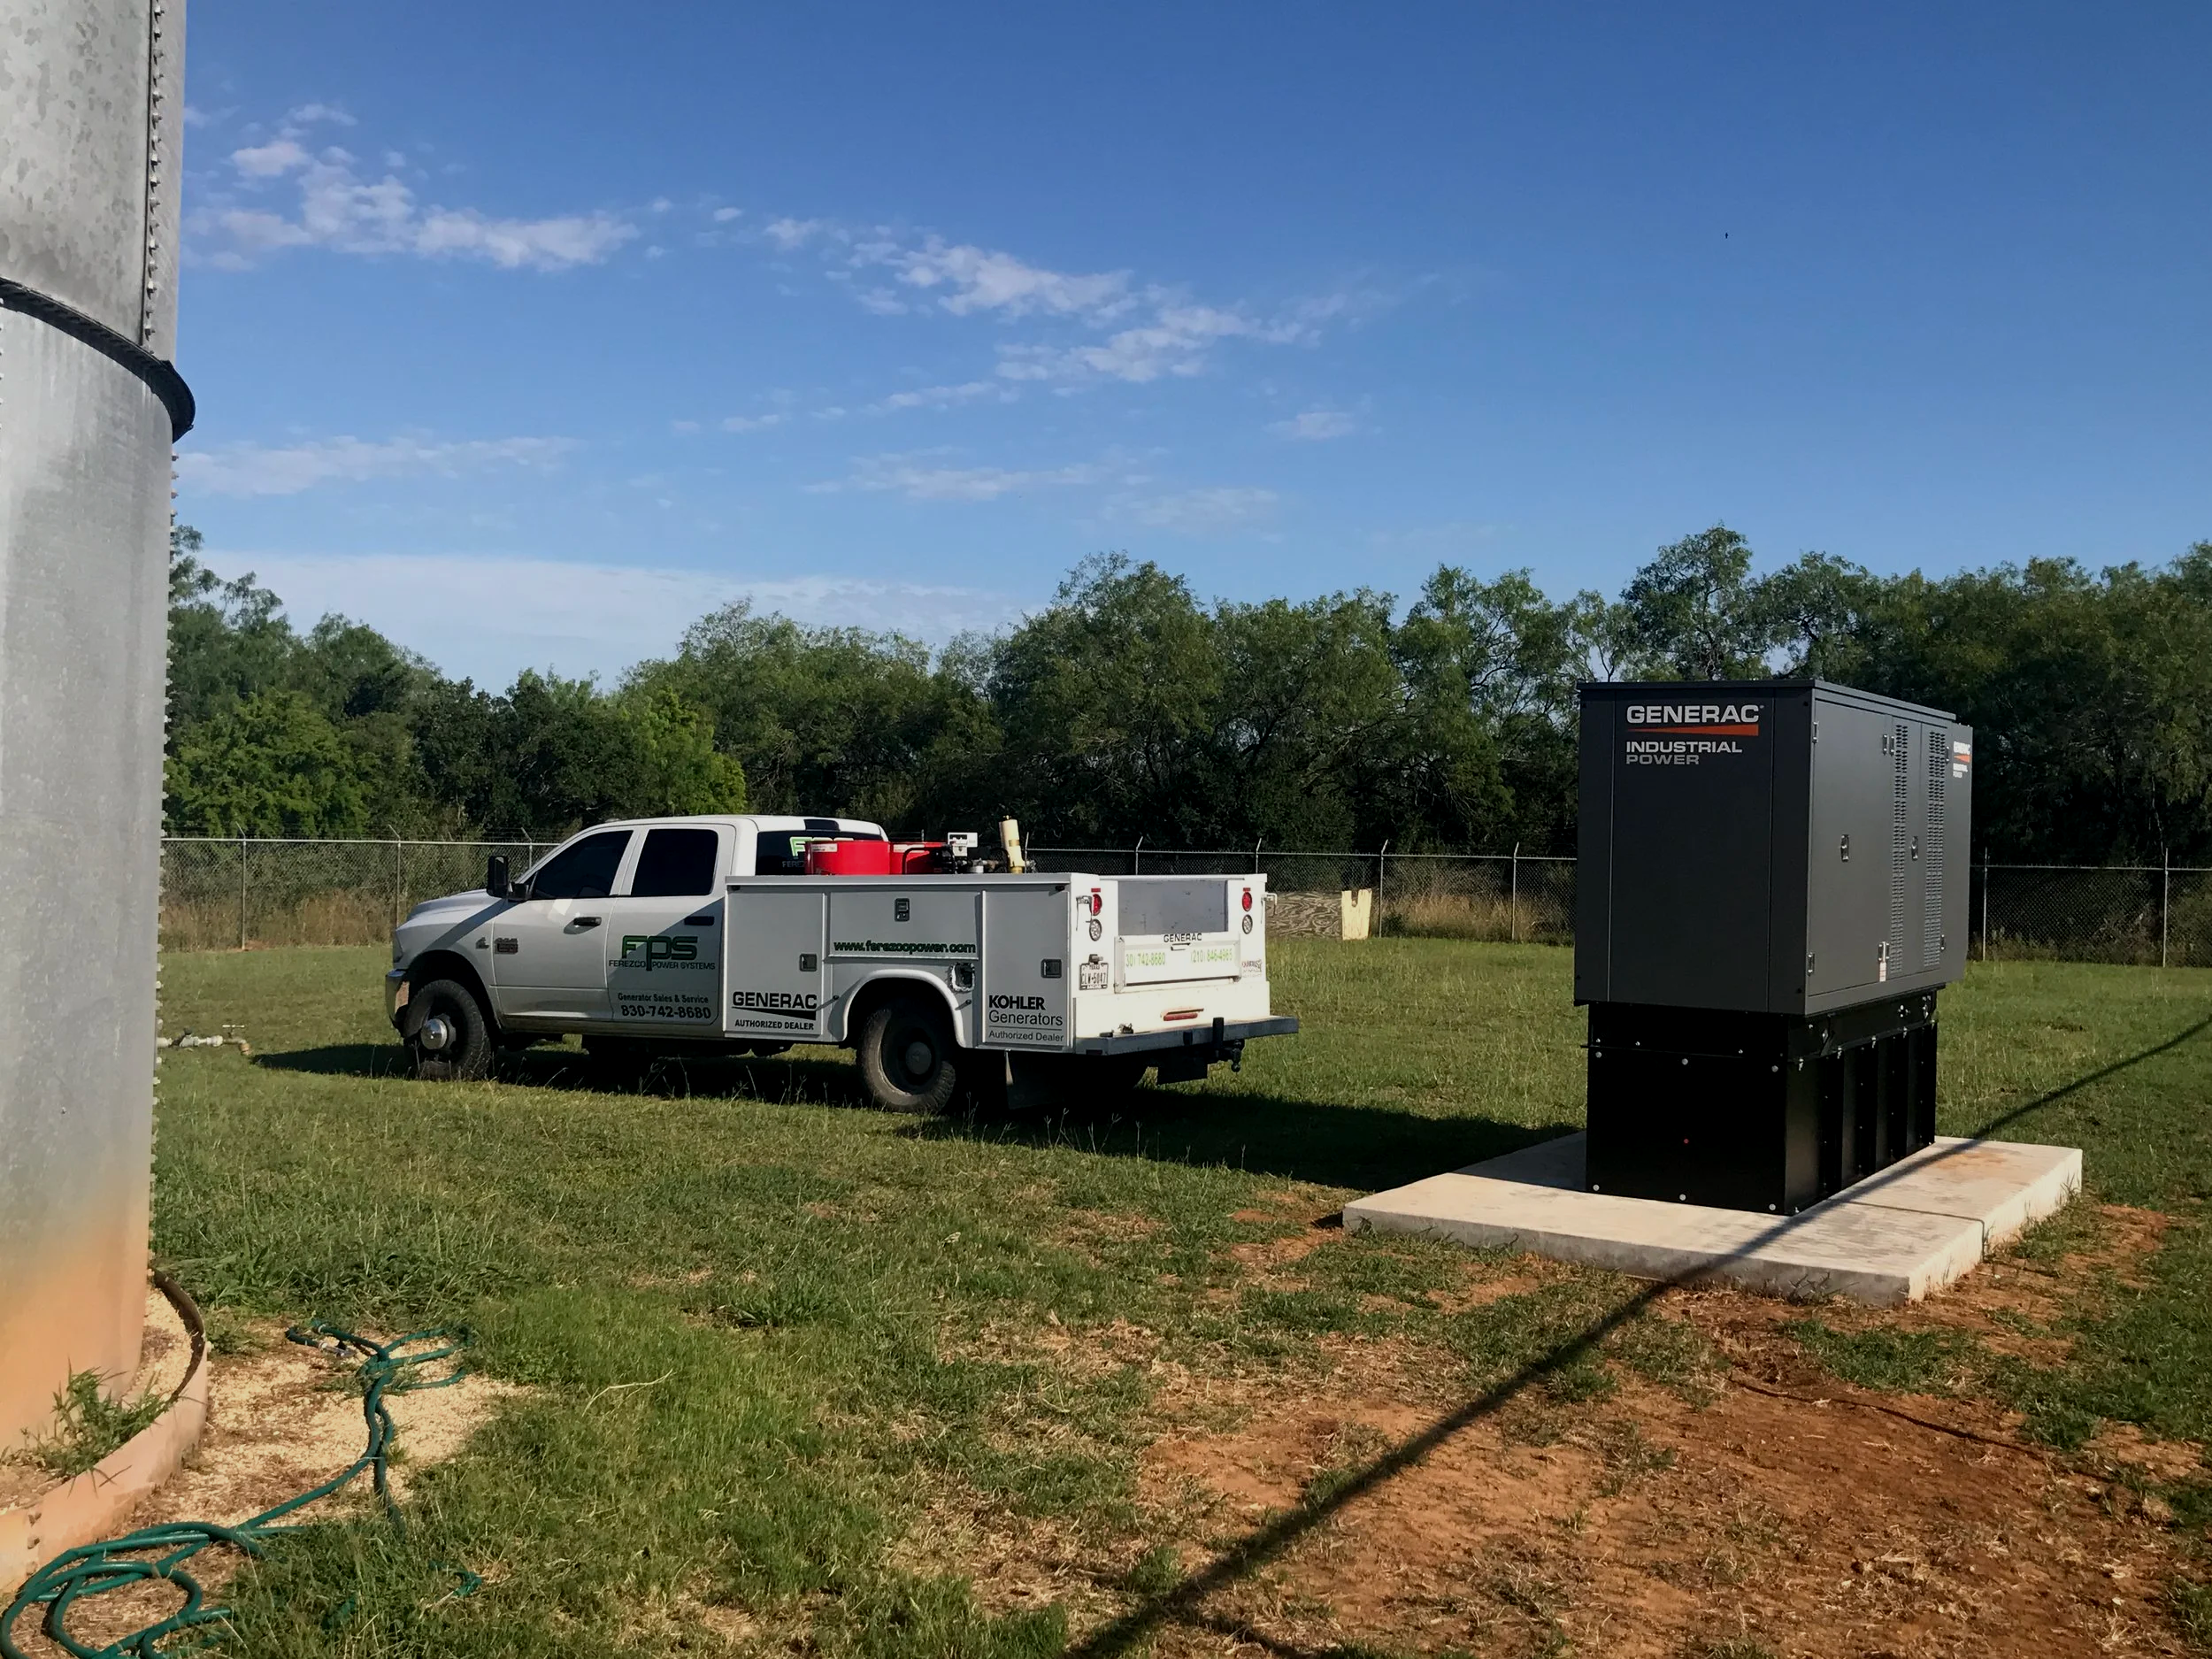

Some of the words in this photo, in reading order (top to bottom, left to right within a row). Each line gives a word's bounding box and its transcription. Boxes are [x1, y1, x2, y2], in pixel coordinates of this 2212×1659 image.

[1626, 705, 1759, 724] GENERAC
[1626, 741, 1742, 753] INDUSTRIAL
[1626, 755, 1699, 764] POWER
[1164, 933, 1202, 943] GENERAC
[618, 993, 651, 1002] Generator
[733, 991, 818, 1010] GENERAC
[988, 995, 1046, 1010] KOHLER
[621, 1005, 711, 1018] 830-742-8680
[734, 1019, 782, 1029] AUTHORIZED
[988, 1010, 1064, 1026] Generators
[988, 1030, 1033, 1040] Authorized
[1035, 1033, 1064, 1041] Dealer
